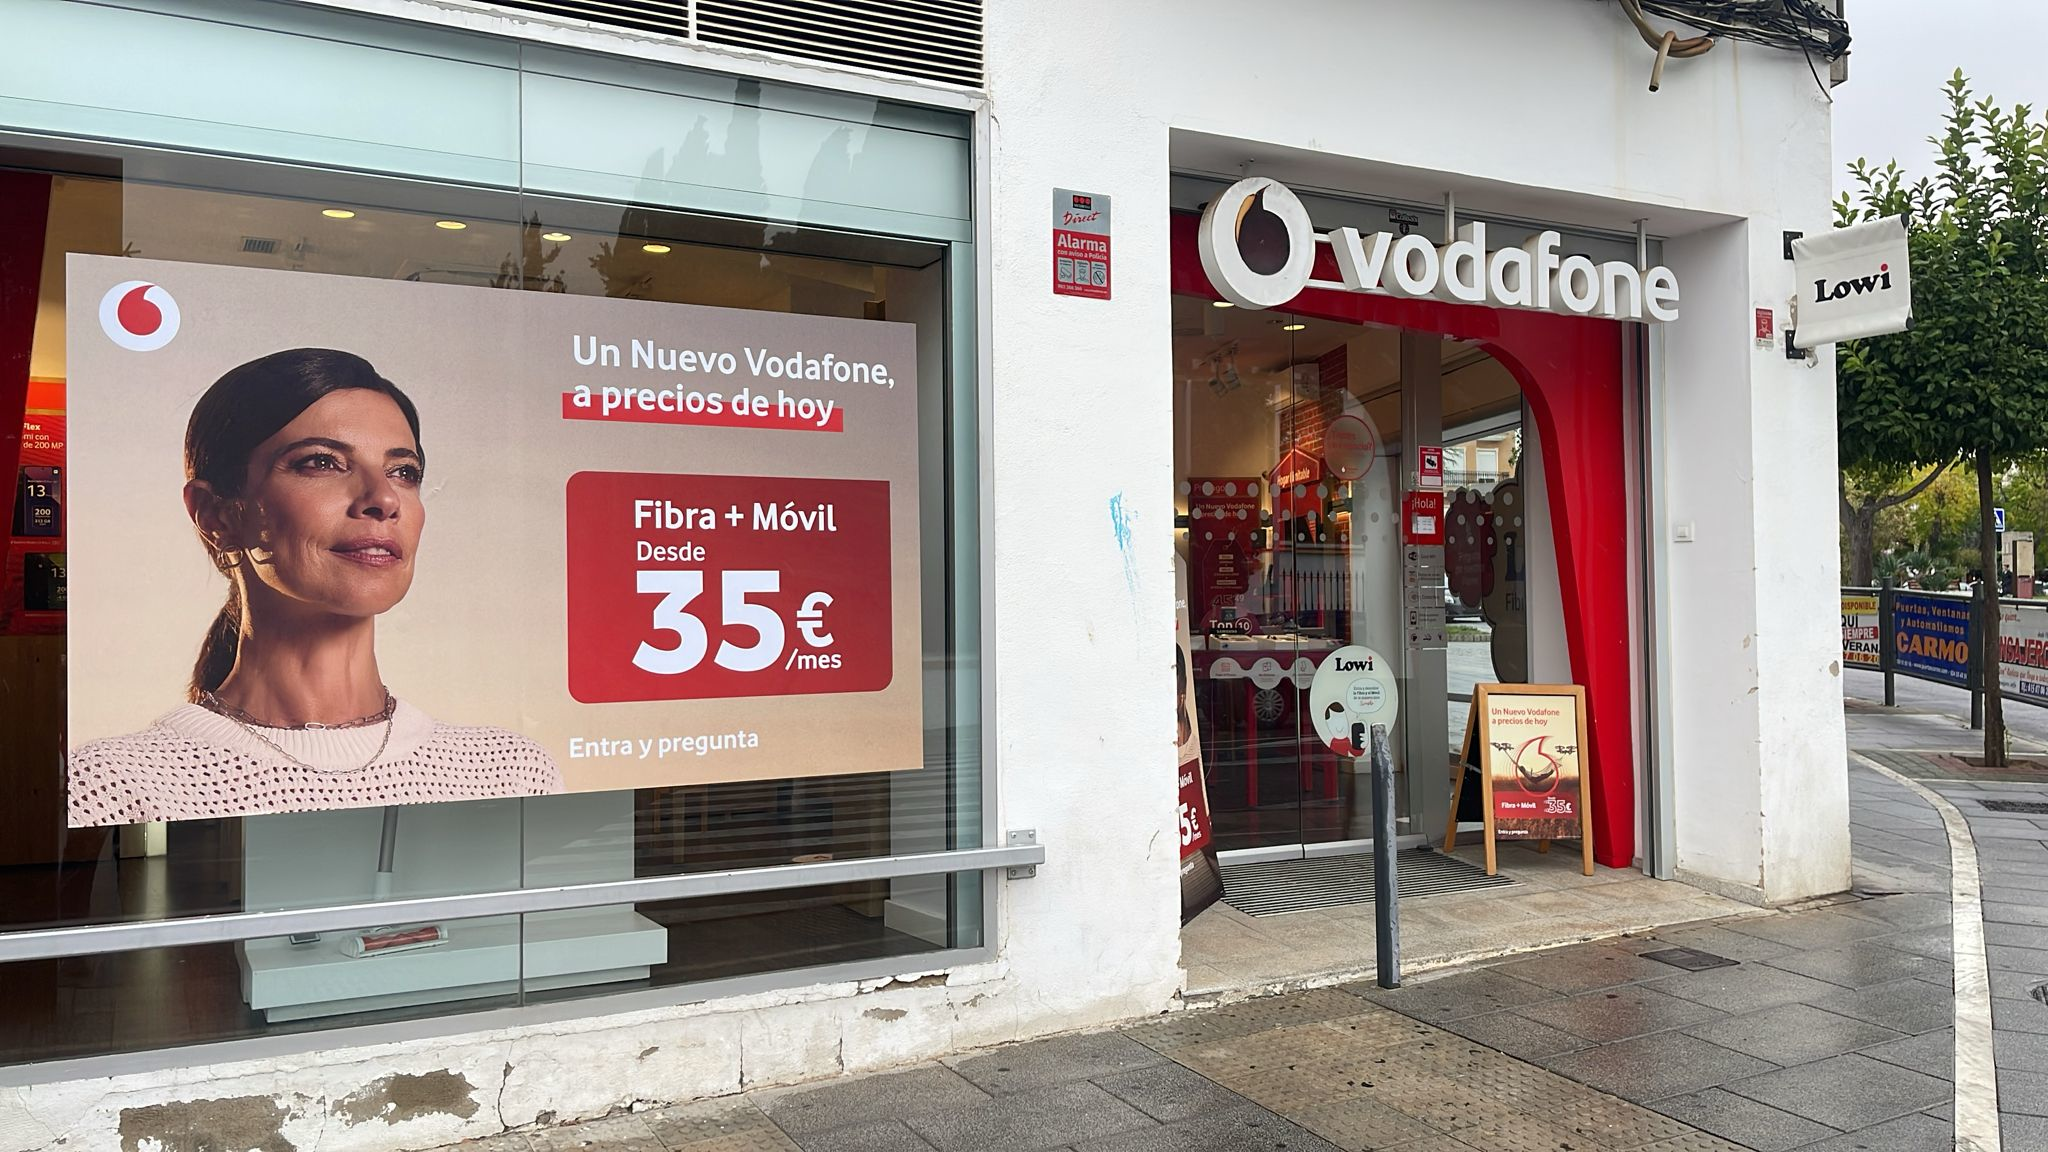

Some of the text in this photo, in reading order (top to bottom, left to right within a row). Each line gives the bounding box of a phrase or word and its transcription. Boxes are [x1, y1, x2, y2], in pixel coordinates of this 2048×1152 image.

[1057, 234, 1107, 252] Alarma
[1329, 222, 1680, 322] vodafone
[1814, 263, 1891, 303] Lowi
[573, 335, 895, 389] Un Nuevo Vodafone,
[572, 383, 834, 427] a precios de hoy
[27, 484, 46, 497] 13
[34, 508, 51, 516] 200
[634, 499, 837, 532] Fibra + Móvil
[636, 541, 706, 561] Desde
[1907, 618, 1964, 635] Automatismos
[1842, 640, 1880, 653] VERAN
[1896, 631, 1969, 664] CARMO
[785, 648, 842, 671] /mes
[1335, 656, 1373, 671] Lowi
[1498, 717, 1523, 726] precios
[1534, 718, 1548, 726] hoy
[1503, 708, 1526, 716] Nuevo
[569, 730, 759, 759] Entra y pregunta
